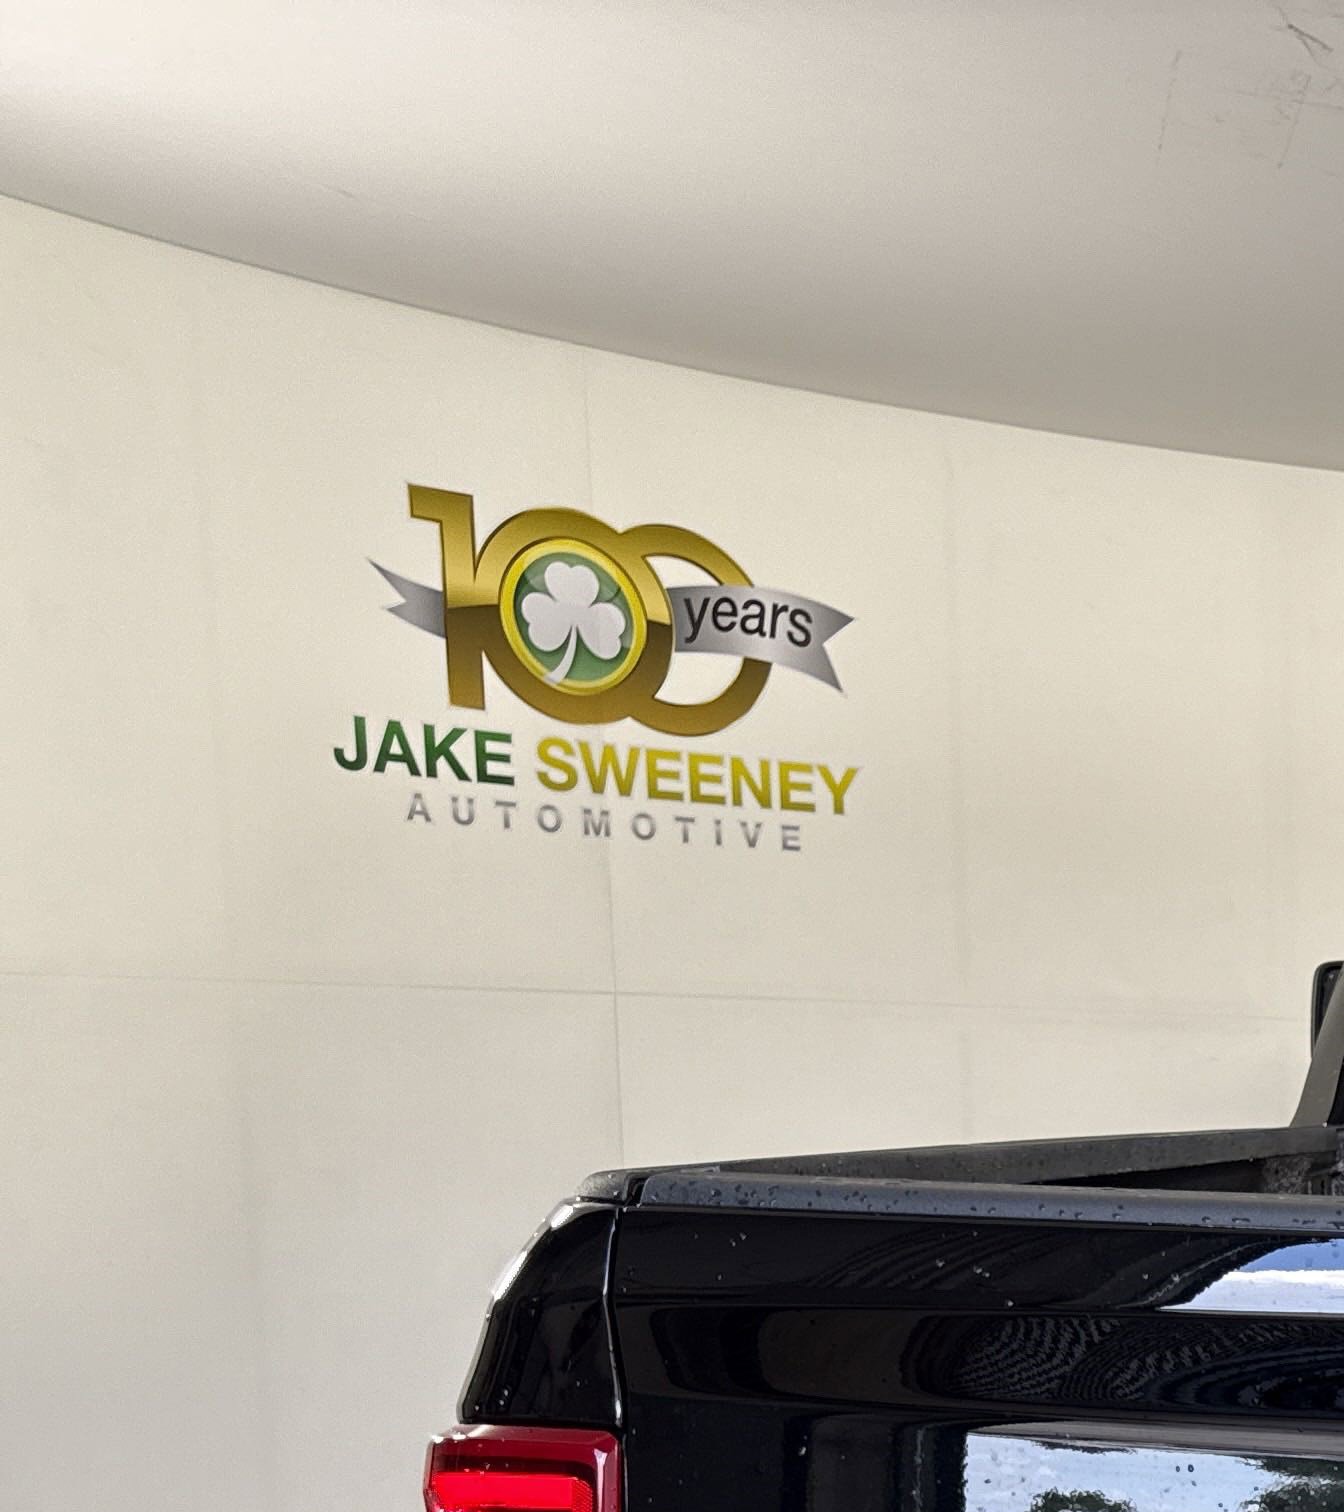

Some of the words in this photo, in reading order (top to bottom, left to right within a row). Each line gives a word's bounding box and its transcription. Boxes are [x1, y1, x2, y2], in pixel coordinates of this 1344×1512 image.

[684, 594, 813, 648] years
[334, 715, 516, 787] JAKE
[535, 736, 859, 816] SWEENEY
[406, 792, 802, 852] AUTOMOTIVE
